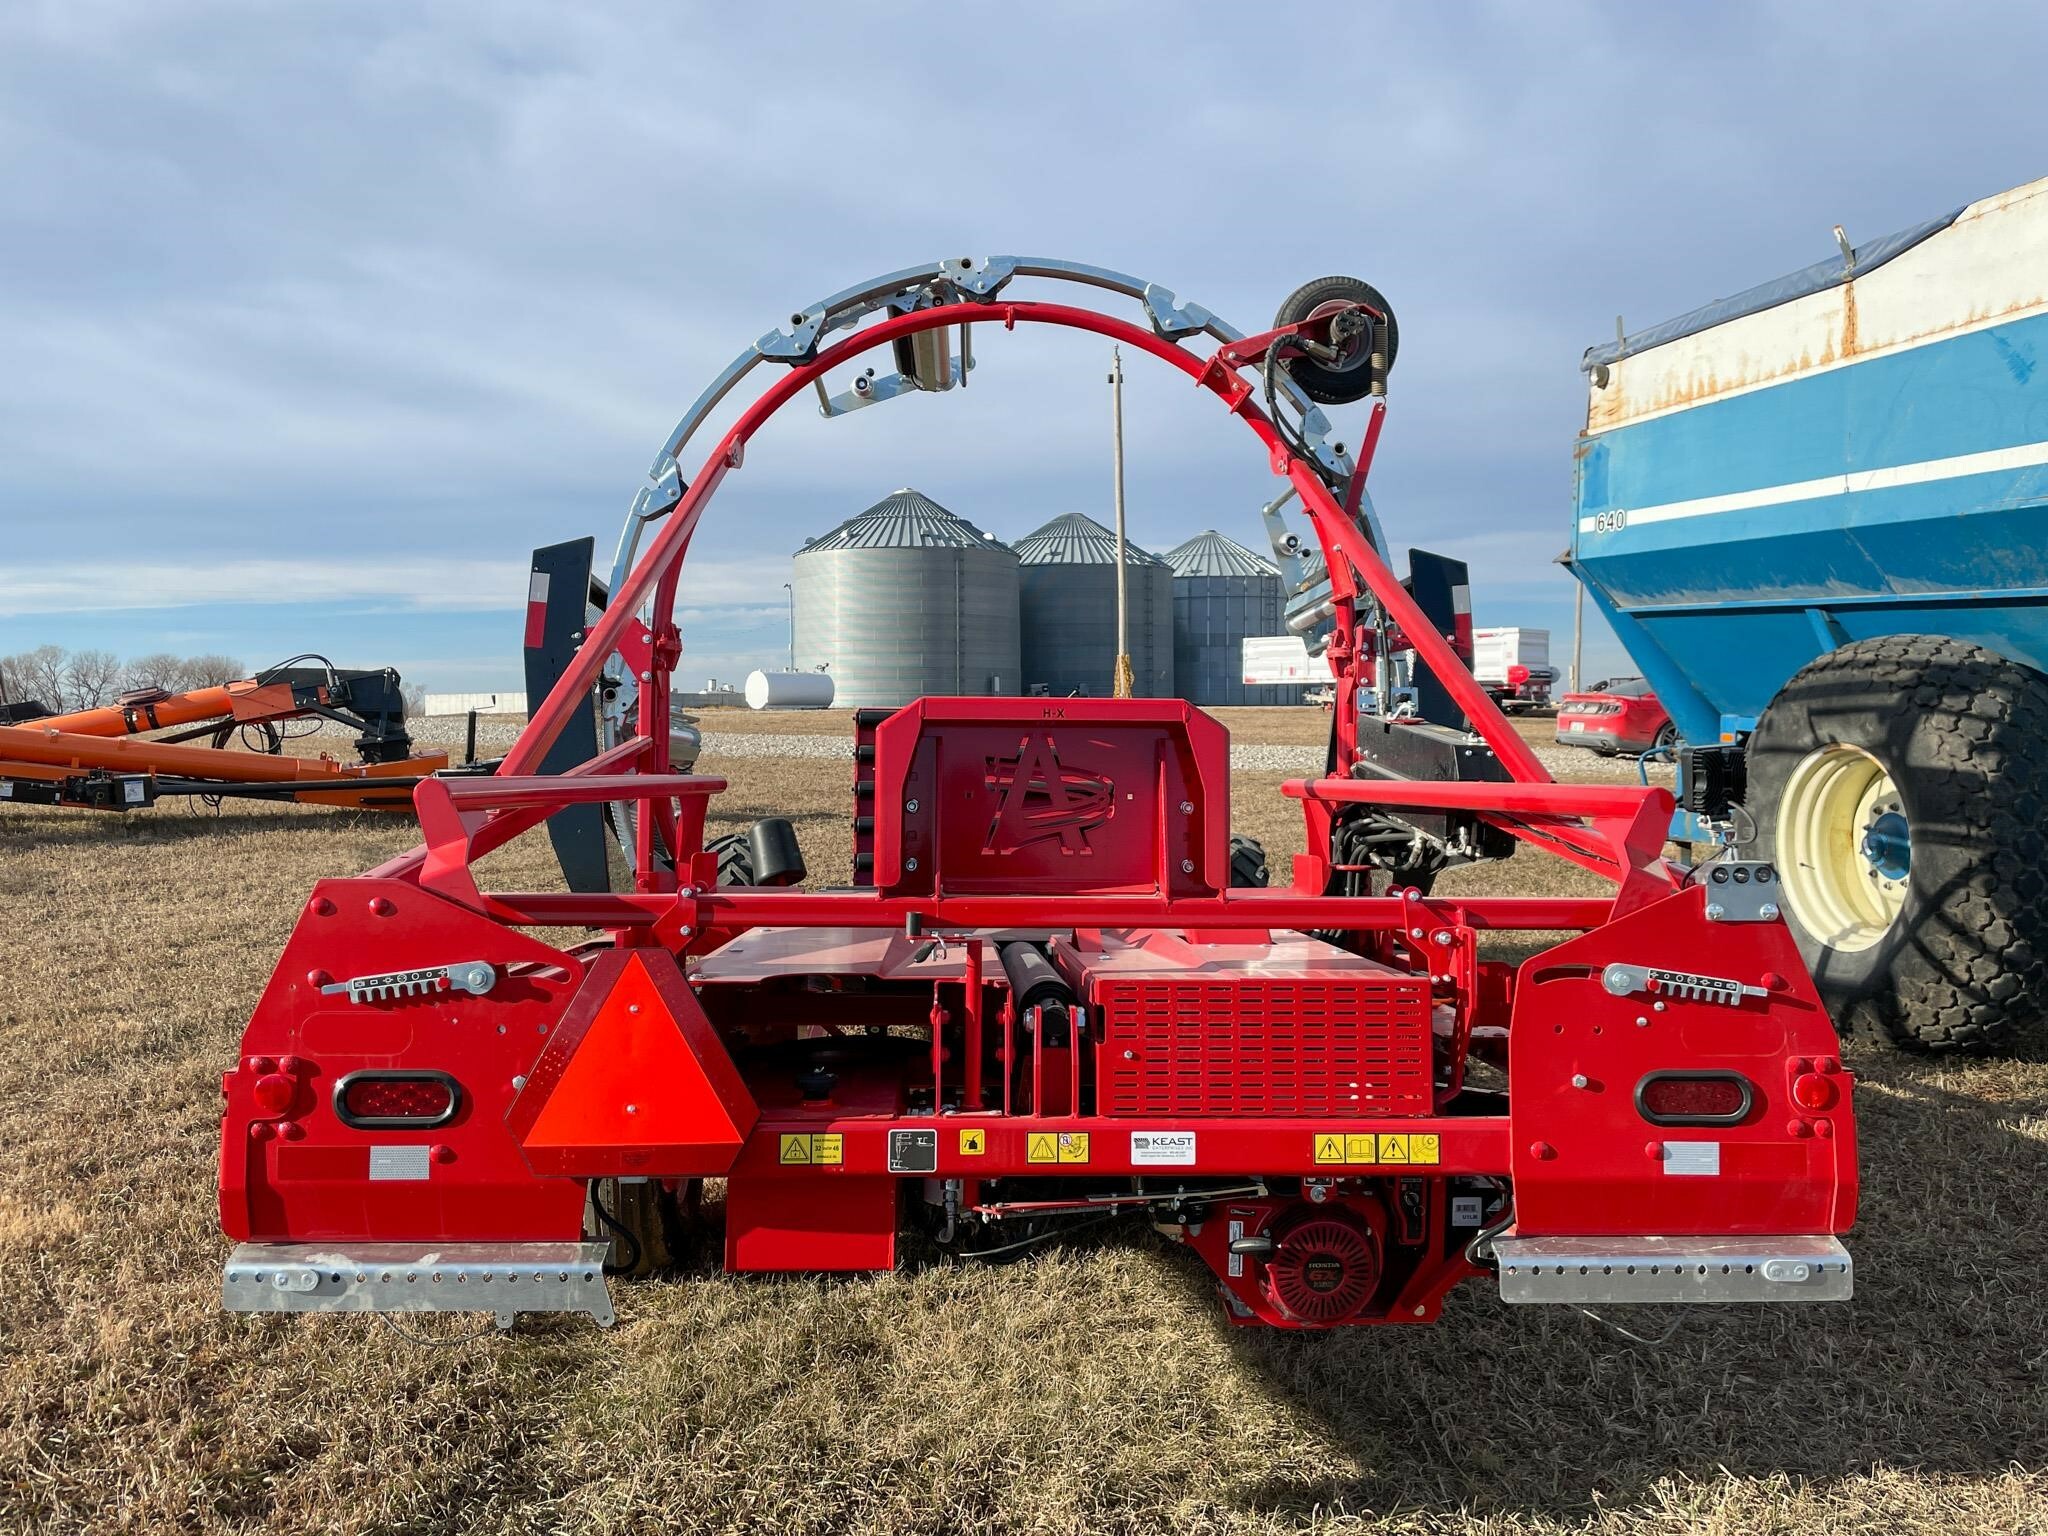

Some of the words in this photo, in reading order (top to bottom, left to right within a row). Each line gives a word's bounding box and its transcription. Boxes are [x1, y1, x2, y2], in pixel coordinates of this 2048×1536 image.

[1597, 511, 1624, 531] 640
[1043, 708, 1065, 718] H-X
[1152, 1137, 1193, 1146] KEAST
